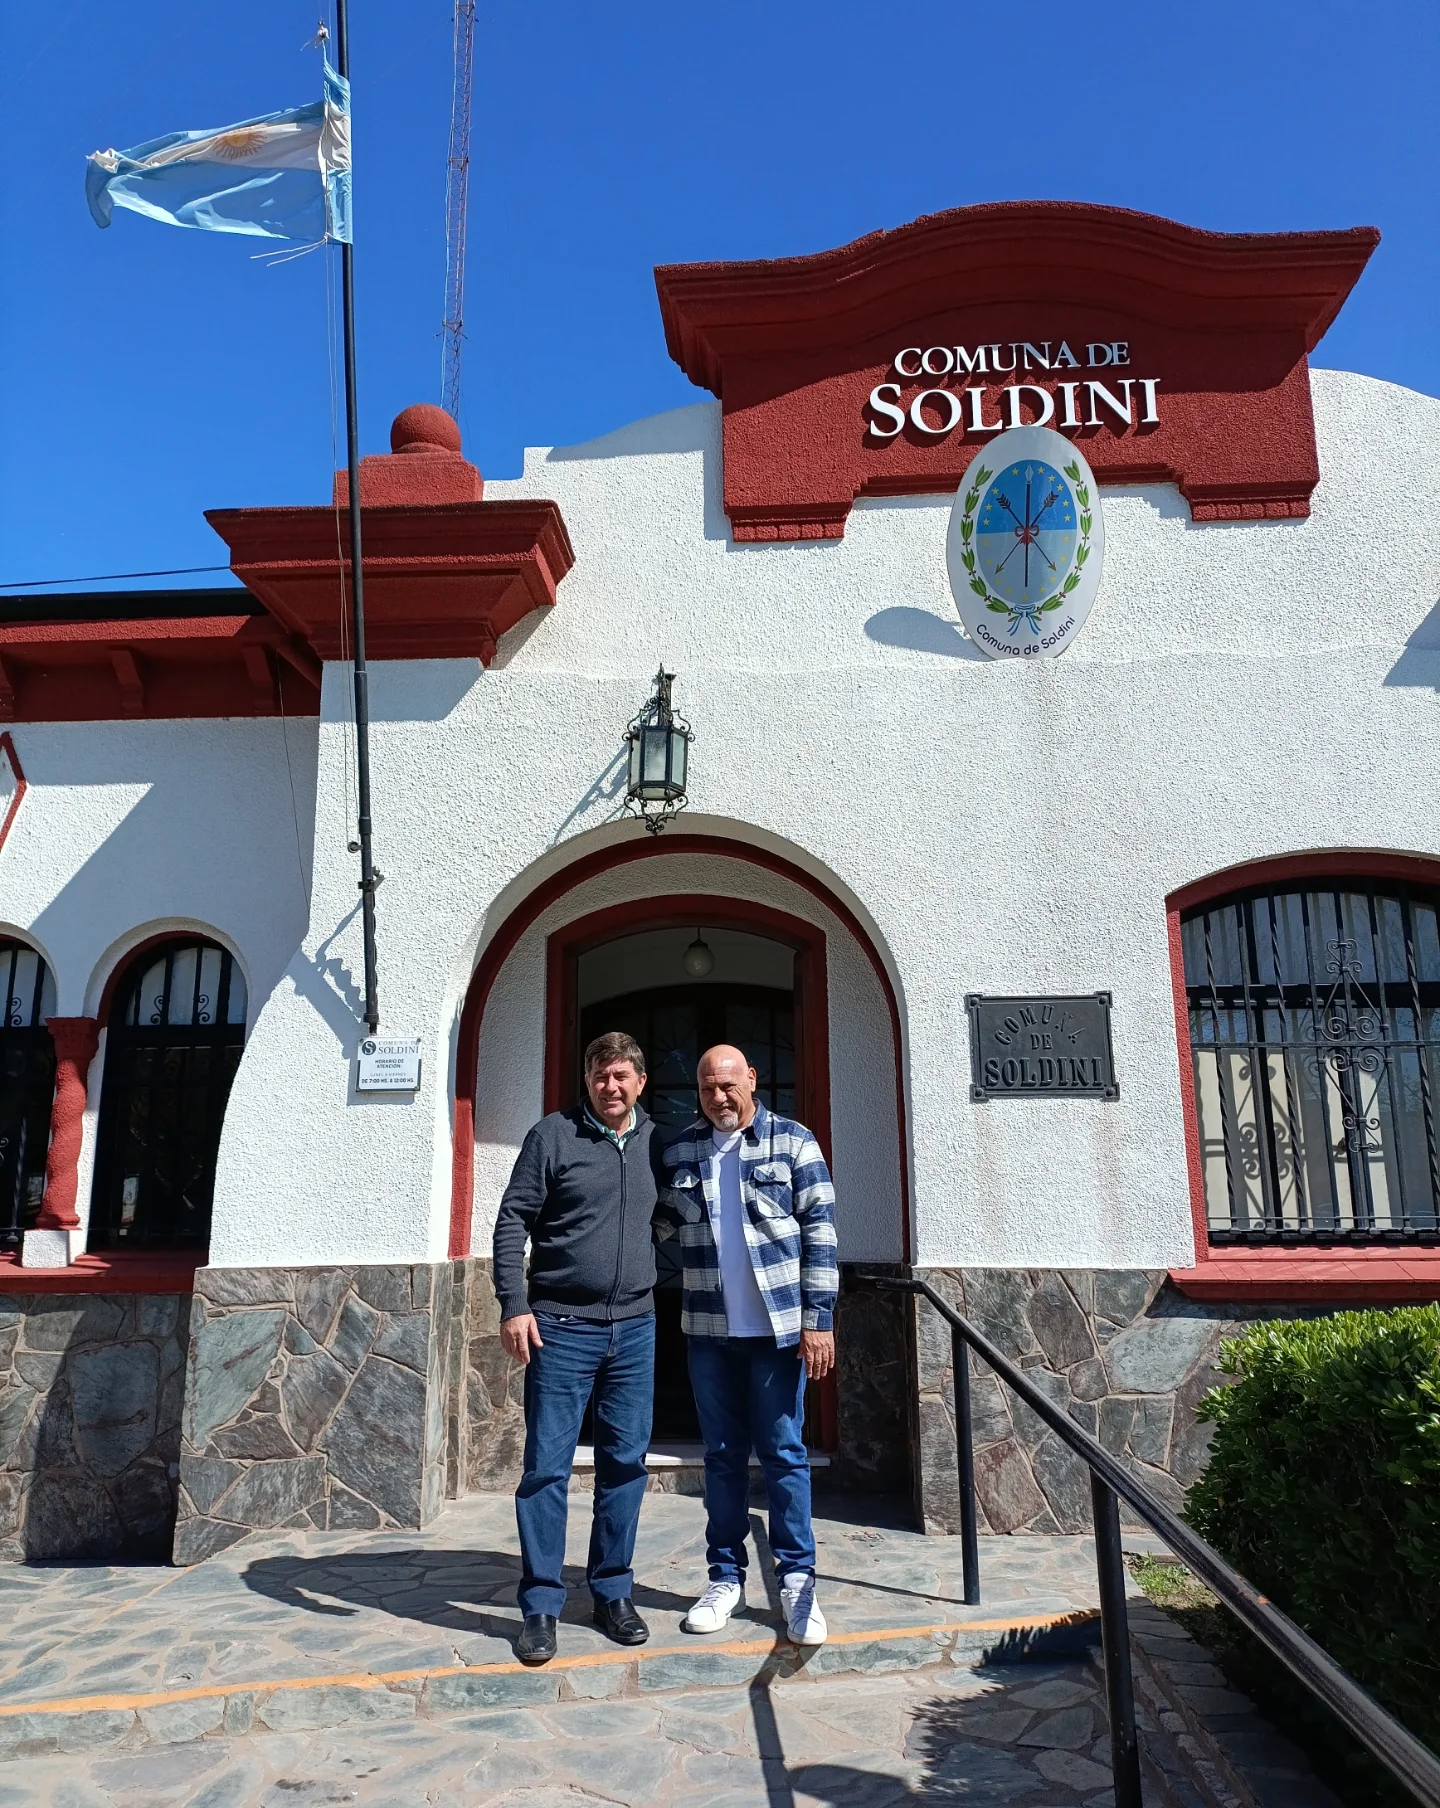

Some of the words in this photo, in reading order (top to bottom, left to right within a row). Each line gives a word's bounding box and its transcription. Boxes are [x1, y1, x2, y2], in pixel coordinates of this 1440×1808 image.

[894, 340, 1080, 376] COMUNA
[1086, 341, 1130, 367] DE
[869, 378, 1160, 437] SOLDINI
[976, 624, 1020, 655] Comuna
[1023, 644, 1040, 655] de
[1041, 615, 1076, 649] Soldini
[994, 1004, 1086, 1045] COMUNA
[1030, 1032, 1053, 1050] DE
[378, 1046, 419, 1054] SOLDINI
[984, 1056, 1103, 1087] SOLDINI
